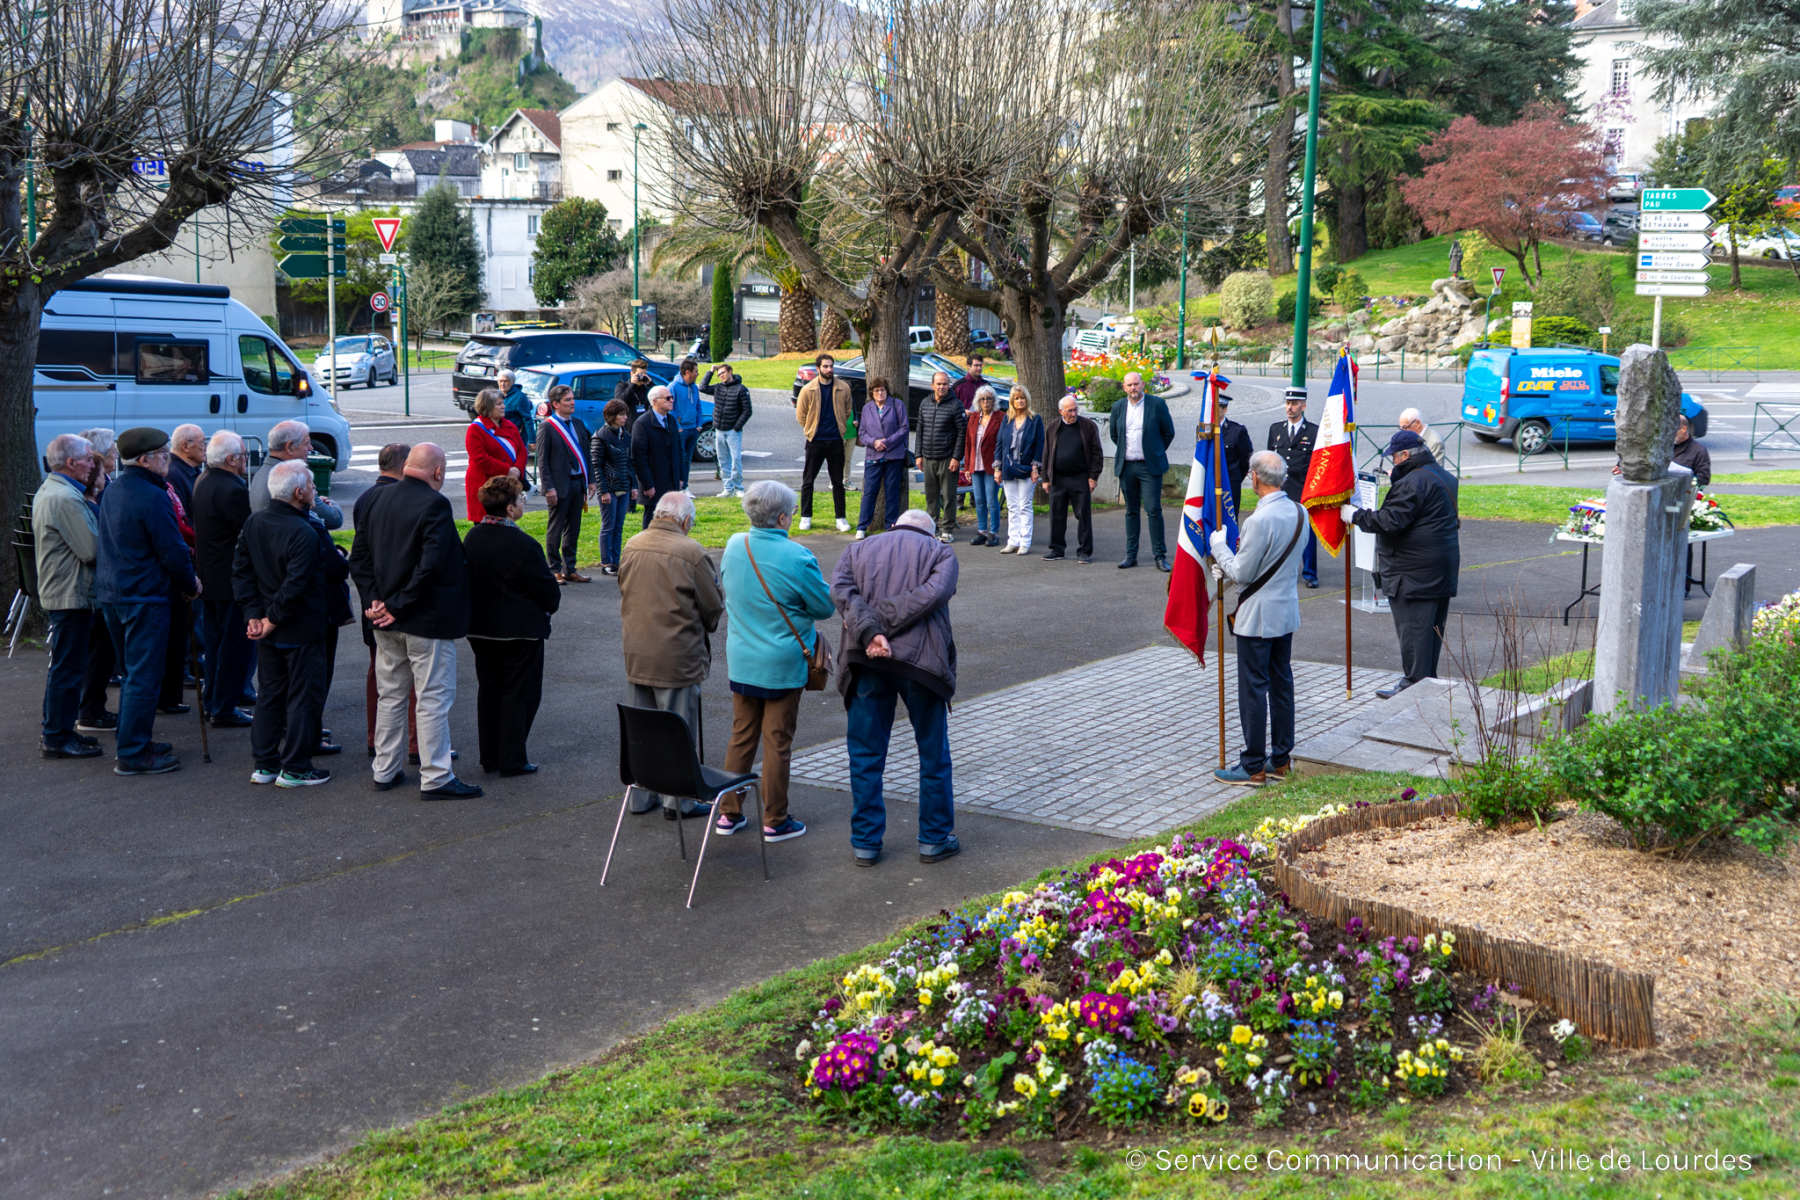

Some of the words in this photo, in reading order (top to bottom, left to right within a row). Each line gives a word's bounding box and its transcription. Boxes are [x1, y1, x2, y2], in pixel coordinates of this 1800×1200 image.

[1646, 192, 1677, 200] TARBES
[375, 298, 386, 307] 30
[1530, 367, 1583, 378] Miele
[1309, 434, 1332, 491] FRANÇAIS
